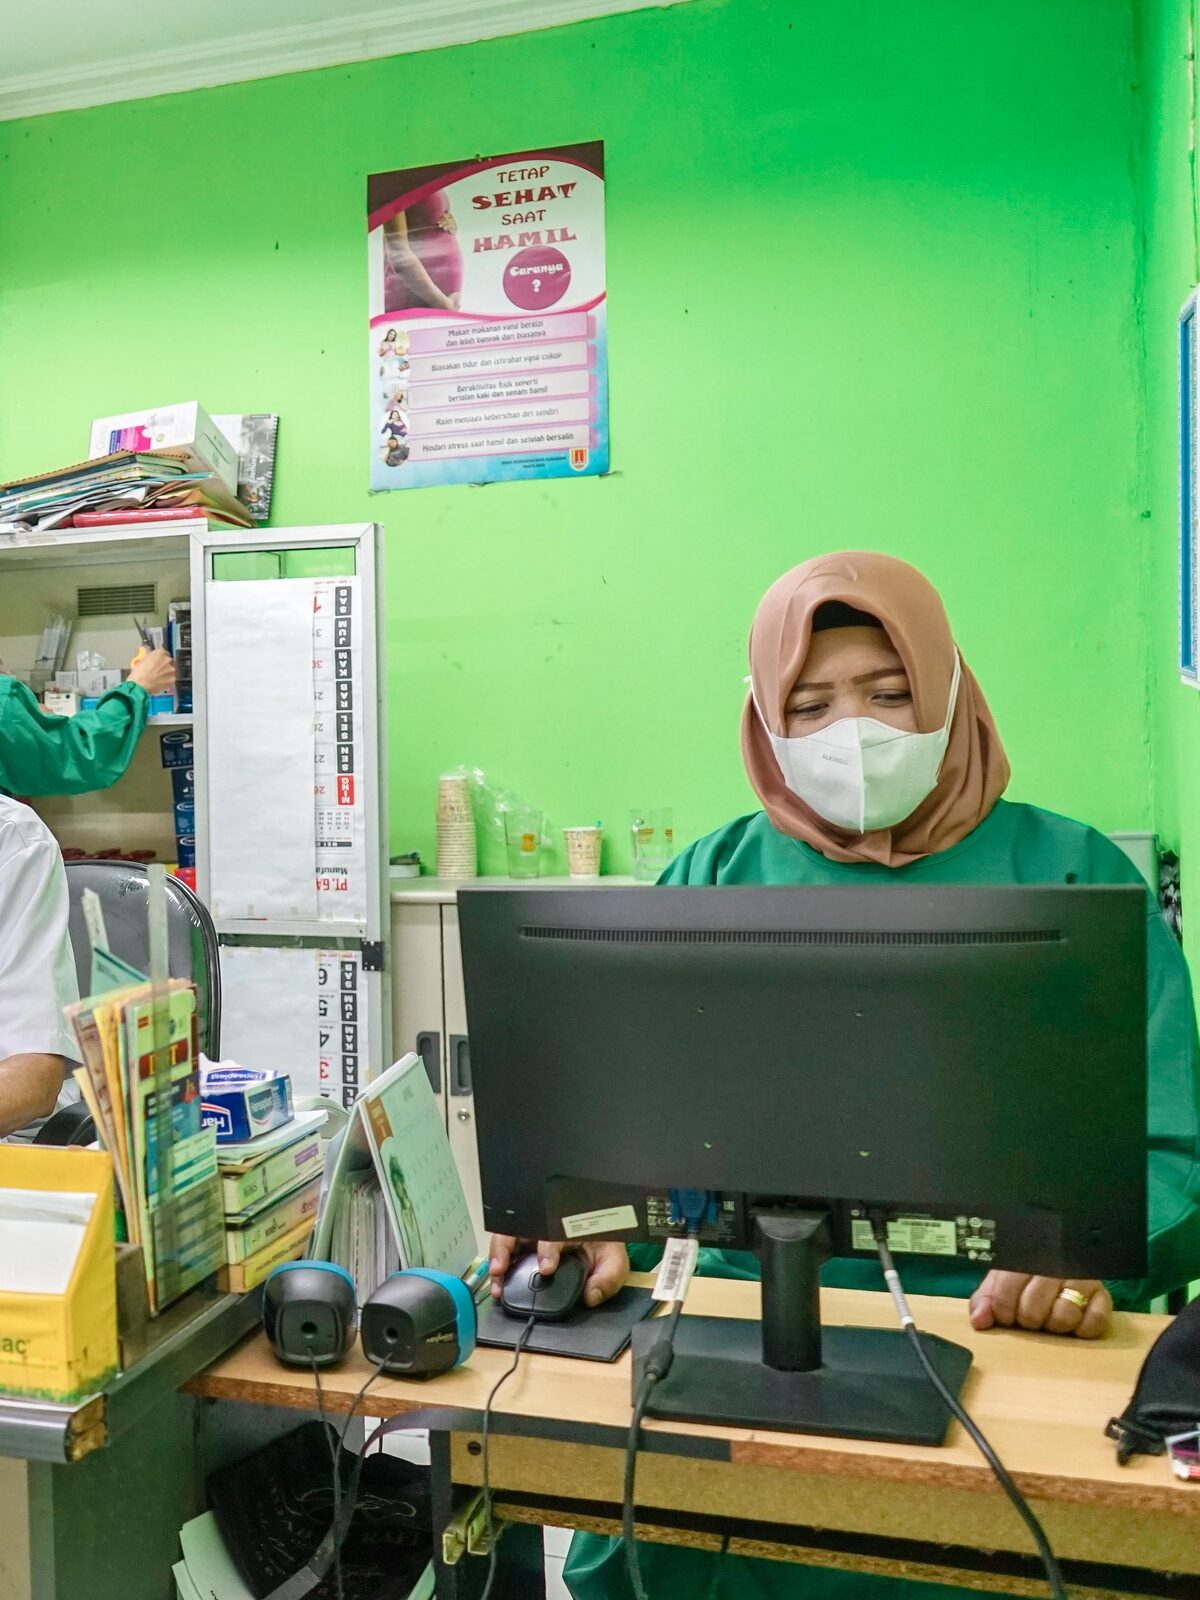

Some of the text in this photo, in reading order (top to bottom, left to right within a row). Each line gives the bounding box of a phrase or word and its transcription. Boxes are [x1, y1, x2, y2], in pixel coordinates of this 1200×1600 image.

[497, 165, 550, 183] TETAP
[471, 182, 577, 210] SEHAT
[501, 209, 547, 226] SAAT
[473, 227, 577, 253] HAMIL
[509, 262, 563, 277] Caranya
[531, 278, 541, 293] ?
[332, 878, 348, 891] PT.
